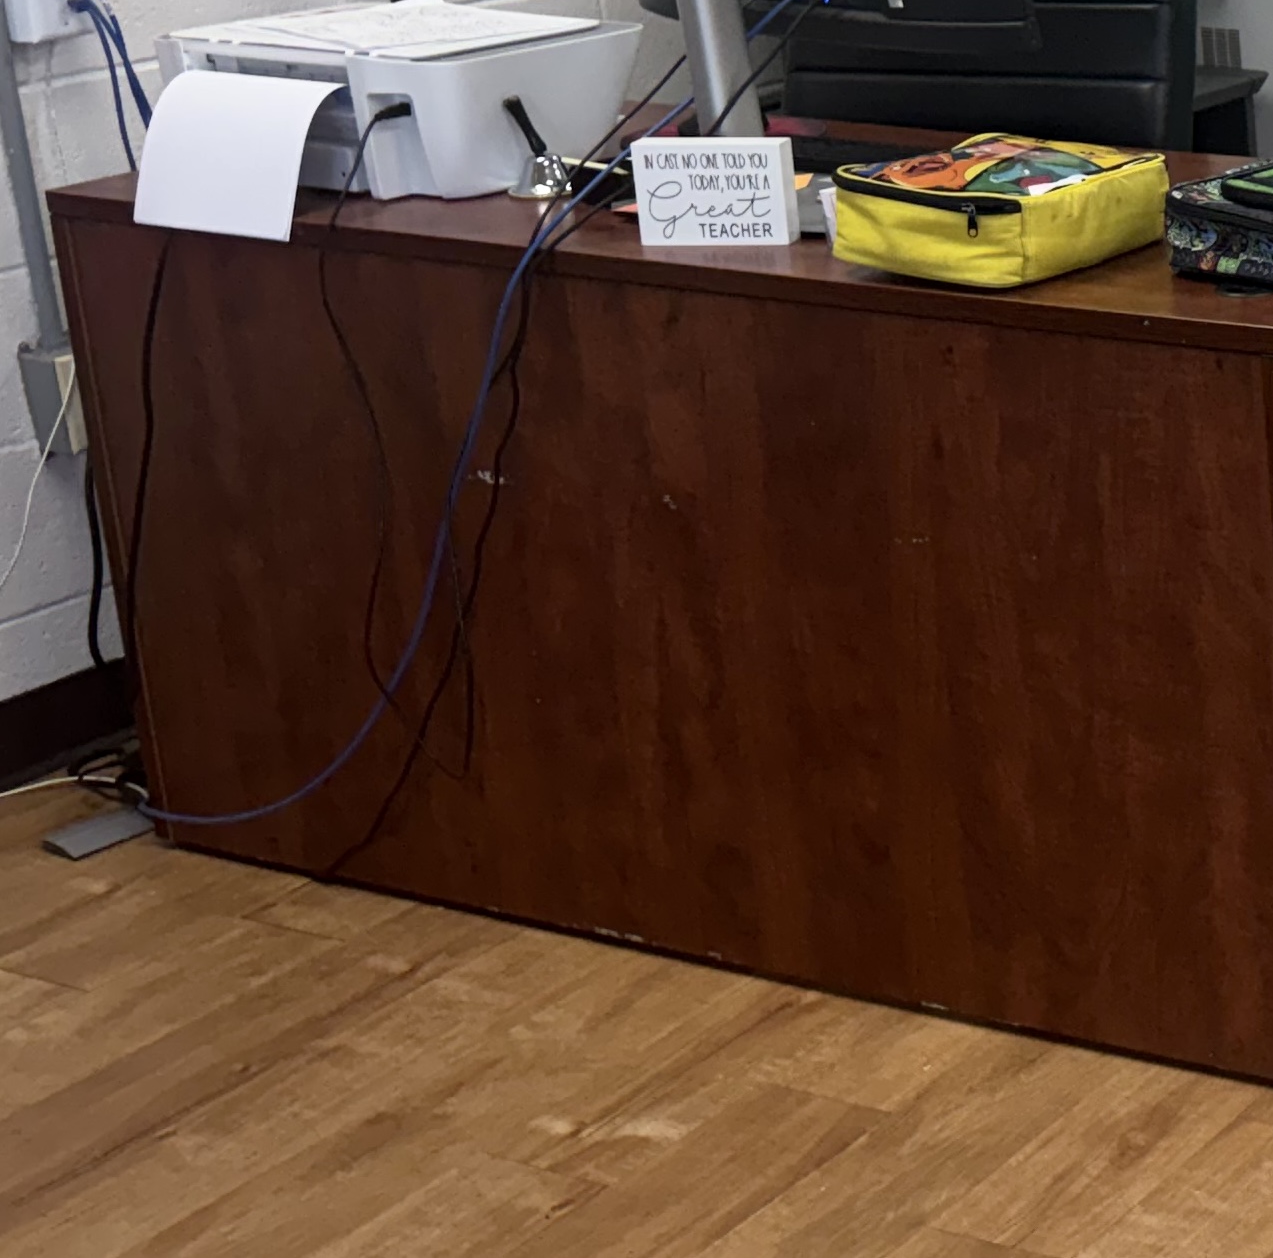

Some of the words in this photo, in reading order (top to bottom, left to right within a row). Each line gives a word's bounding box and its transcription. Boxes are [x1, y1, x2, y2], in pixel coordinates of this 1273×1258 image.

[643, 154, 654, 169] IN
[656, 153, 678, 170] CASE
[681, 153, 698, 170] NO
[699, 153, 720, 170] ONE
[722, 153, 746, 170] TOLD
[747, 153, 768, 169] YOU
[688, 174, 725, 193] TODAY,
[763, 174, 771, 191] A
[646, 180, 772, 240] Great
[698, 222, 773, 238] TEACHER
